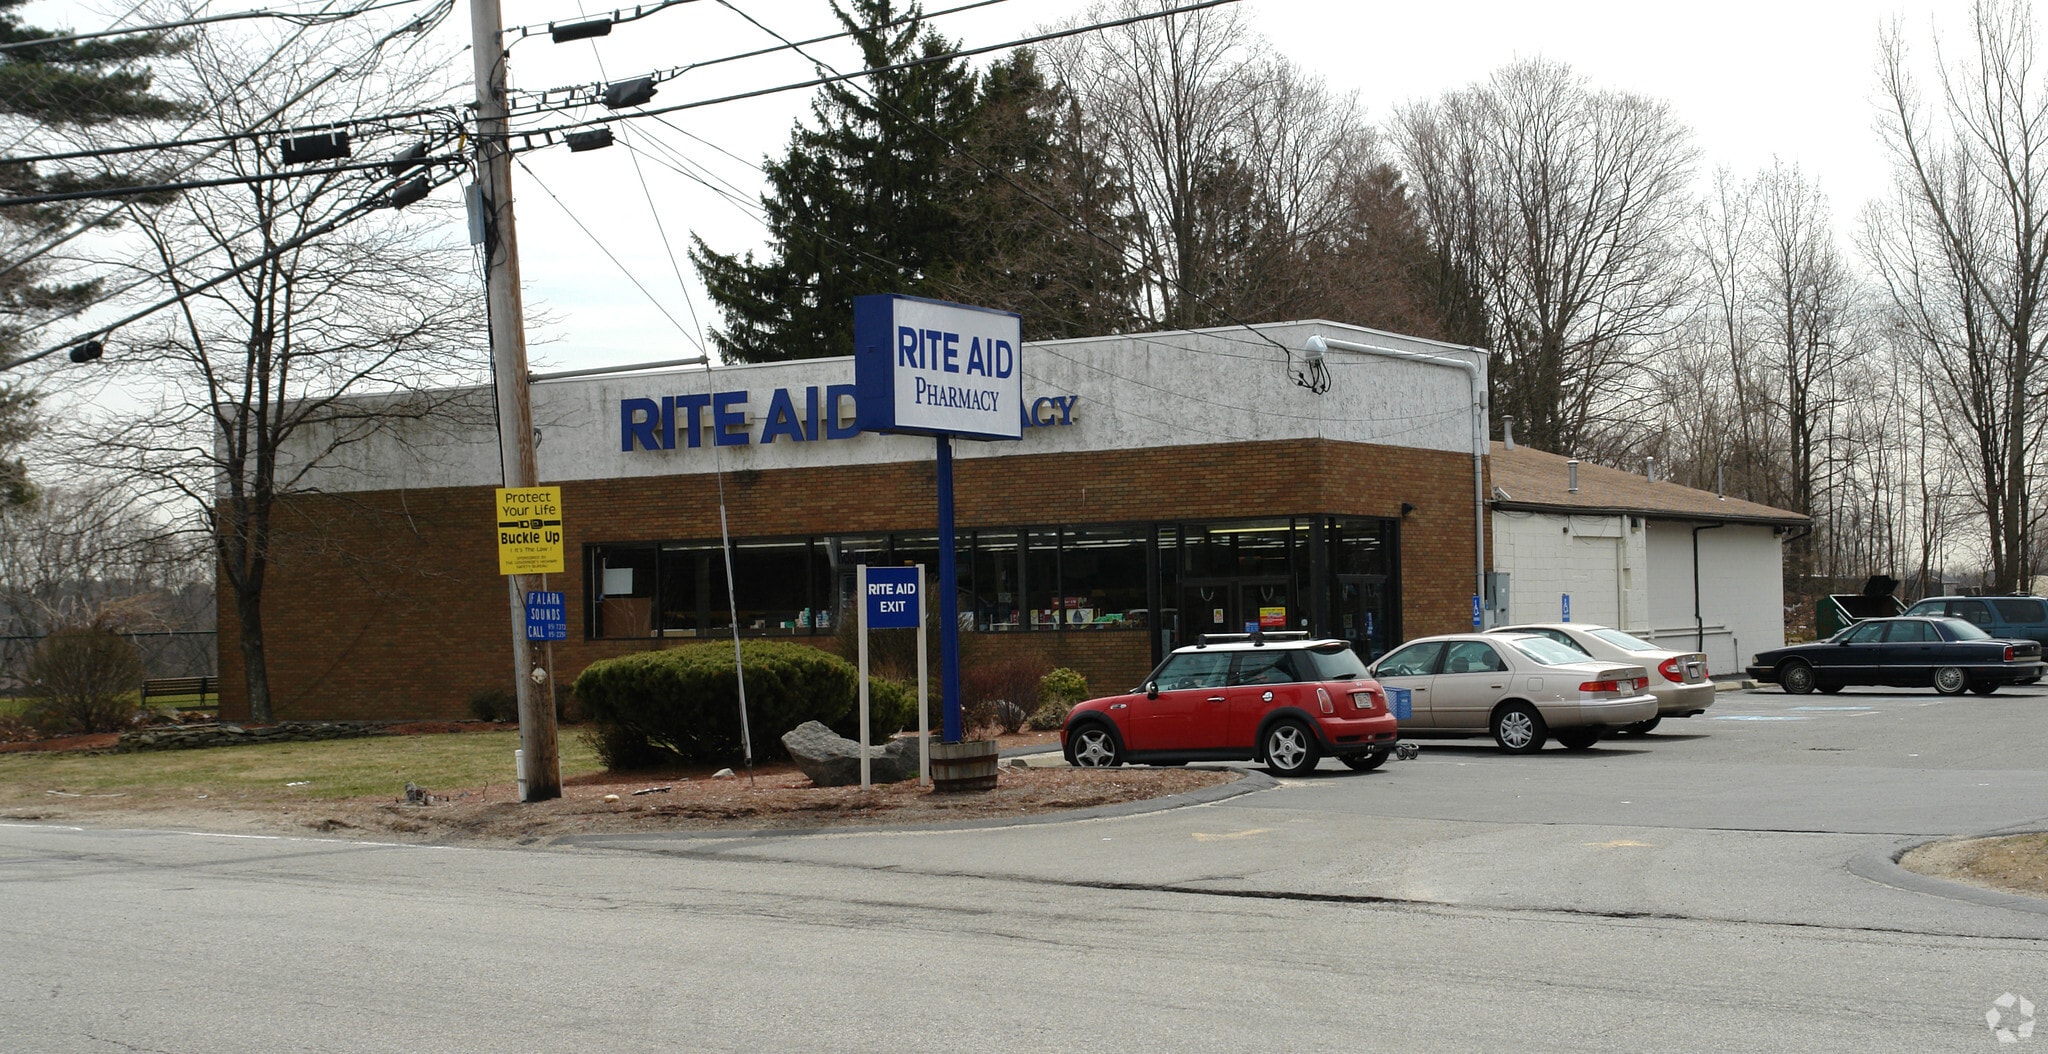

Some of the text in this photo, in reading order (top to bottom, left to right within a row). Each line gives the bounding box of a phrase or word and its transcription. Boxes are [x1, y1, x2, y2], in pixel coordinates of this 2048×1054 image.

[898, 325, 1013, 379] RITE AID
[915, 376, 999, 412] PHARMACY
[620, 390, 750, 452] RITE
[760, 383, 863, 444] AID
[505, 492, 551, 503] Protect
[502, 504, 556, 516] Your Life
[501, 531, 560, 544] Buckle Up
[868, 583, 916, 595] RITE AID
[528, 592, 535, 605] IF
[530, 607, 560, 620] SOUNDS
[880, 601, 906, 613] EXIT
[528, 625, 544, 638] CALL
